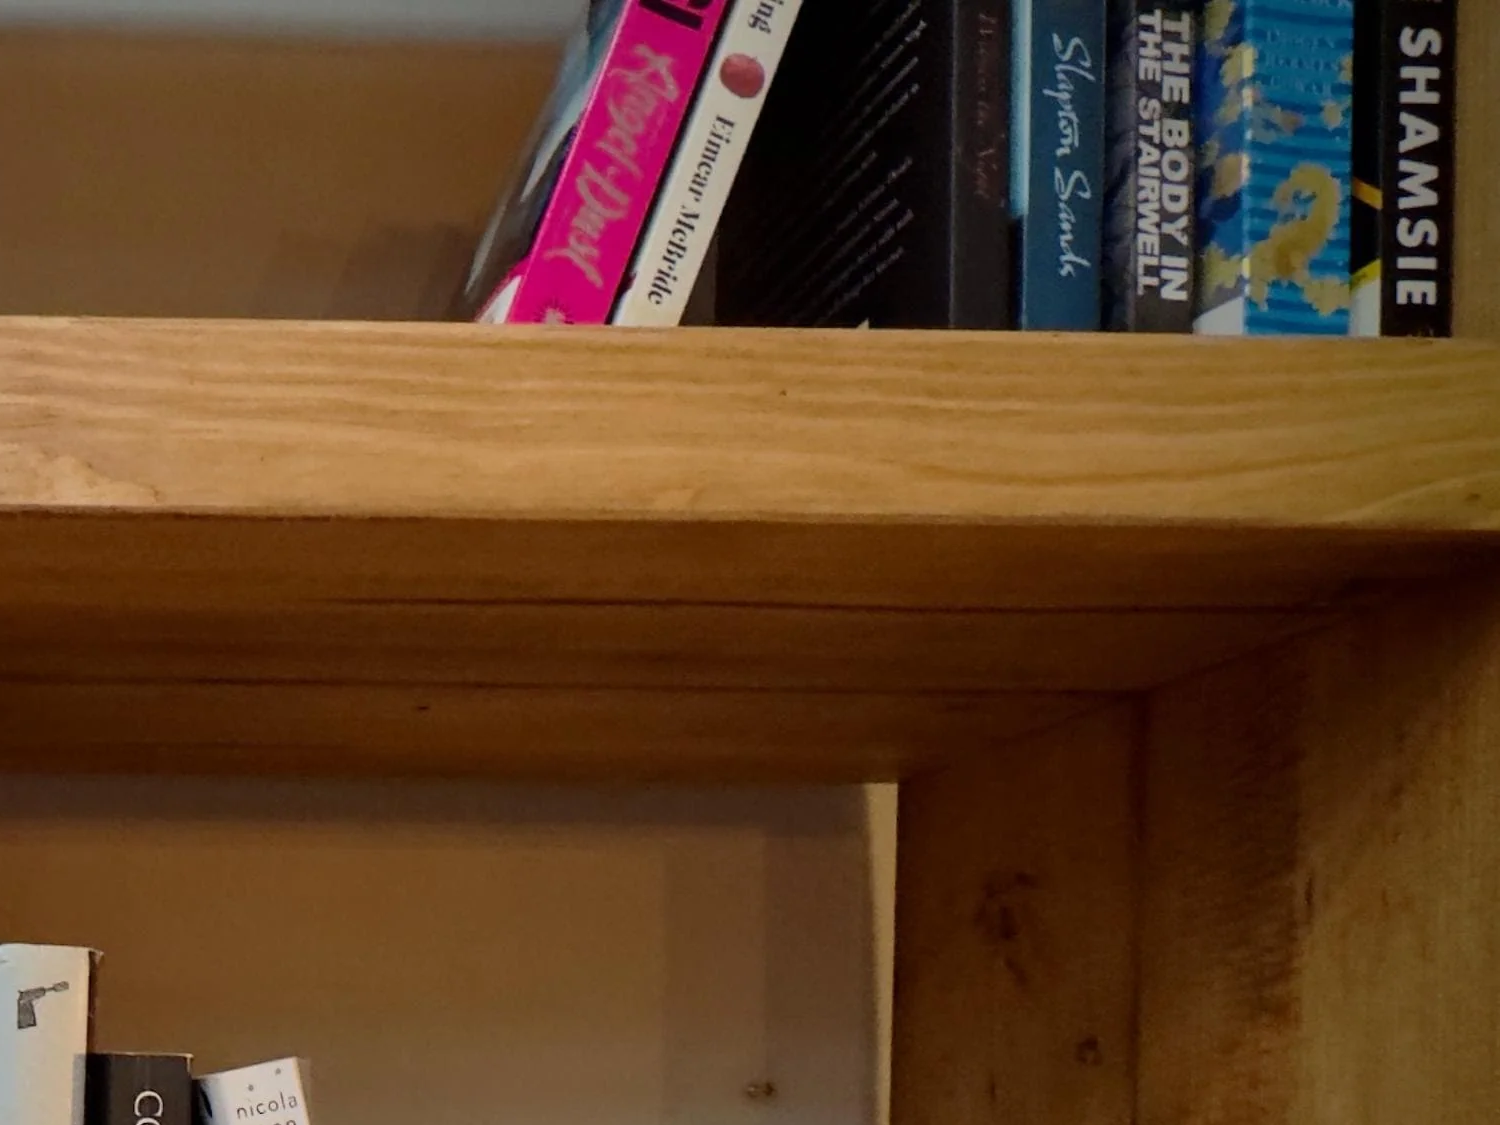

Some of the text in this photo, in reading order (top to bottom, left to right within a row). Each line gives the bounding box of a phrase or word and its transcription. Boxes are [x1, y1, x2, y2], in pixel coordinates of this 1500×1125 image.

[647, 115, 736, 306] Eimear McBride
[1043, 33, 1095, 278] Slapton Sands
[1136, 9, 1163, 297] THE STAIRWELL
[1160, 12, 1190, 302] THE BODY IN
[1395, 26, 1443, 307] SHAMSIE
[236, 1091, 298, 1119] nicola
